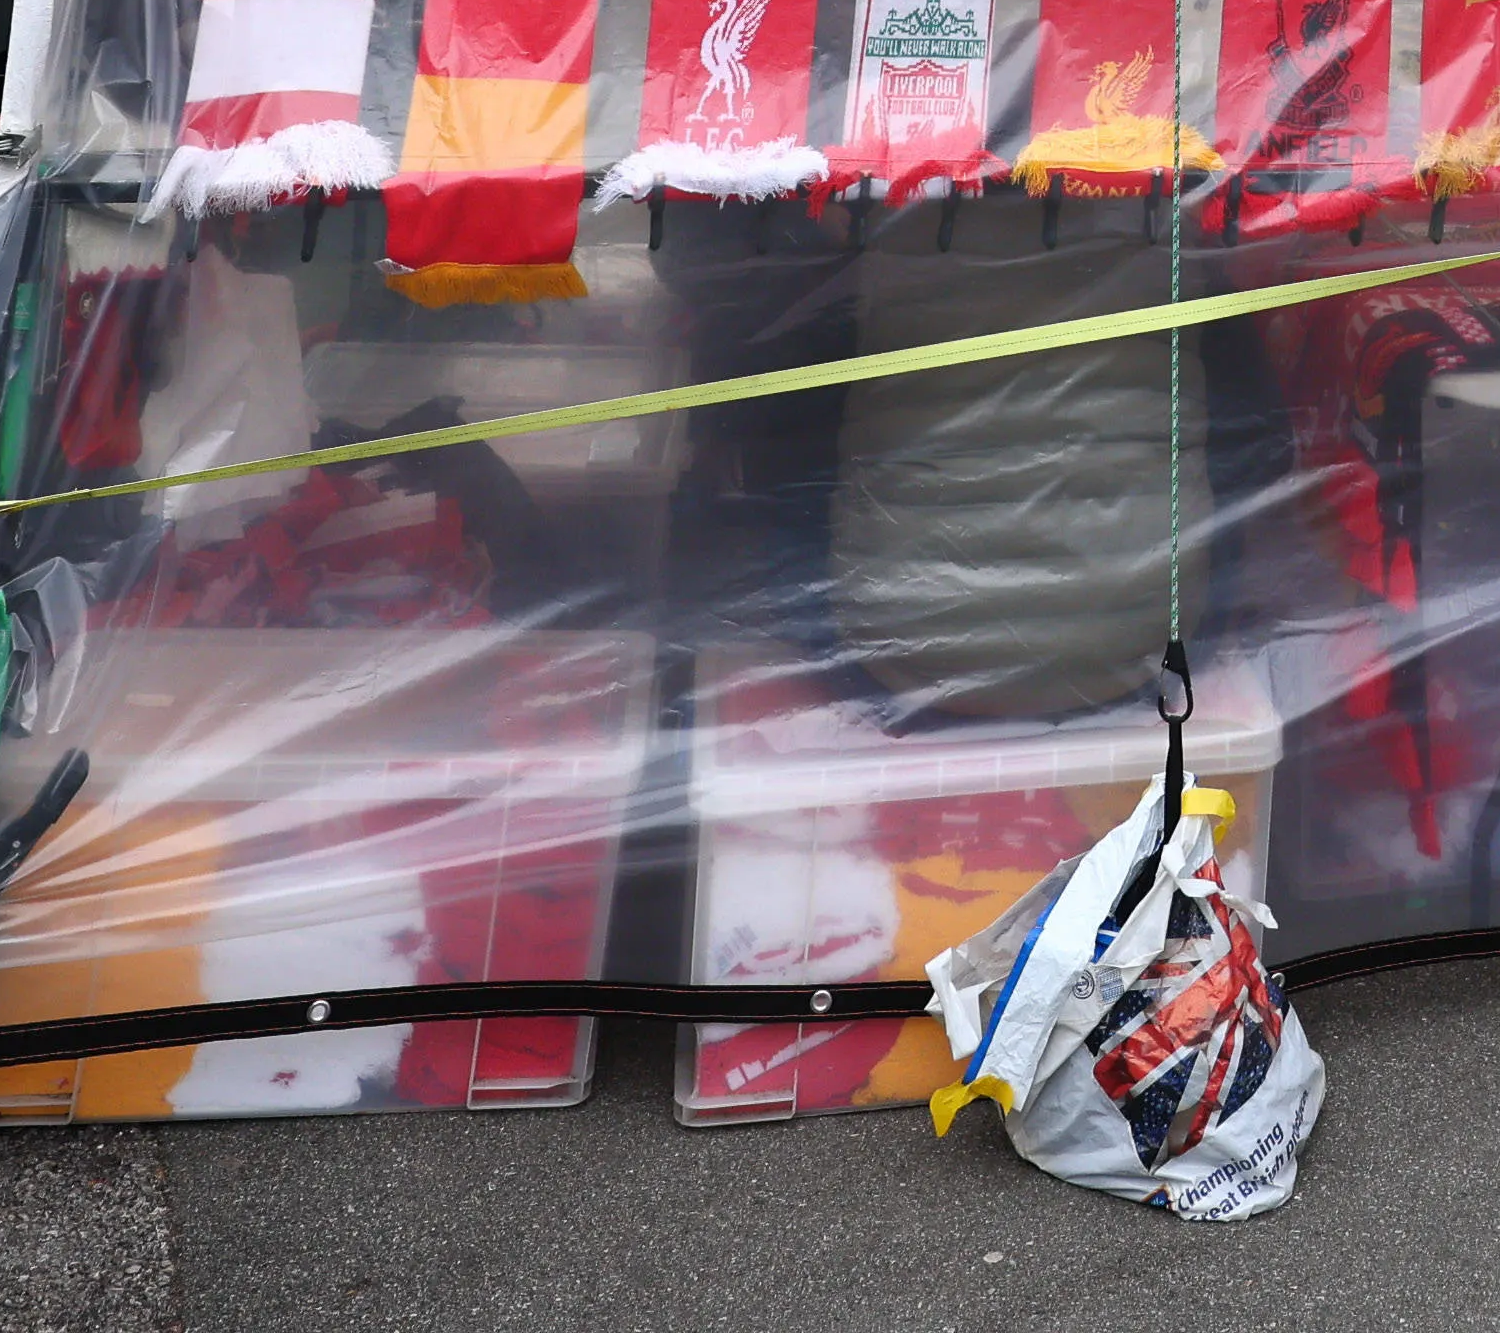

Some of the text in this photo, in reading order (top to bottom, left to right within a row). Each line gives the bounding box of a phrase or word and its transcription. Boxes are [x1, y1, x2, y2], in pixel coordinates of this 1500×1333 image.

[867, 38, 985, 57] YOU'LL NEVER WALK ALONE
[886, 75, 959, 96] LIVERPOOL
[1177, 1122, 1286, 1213] Championing
[1237, 1158, 1285, 1200] British
